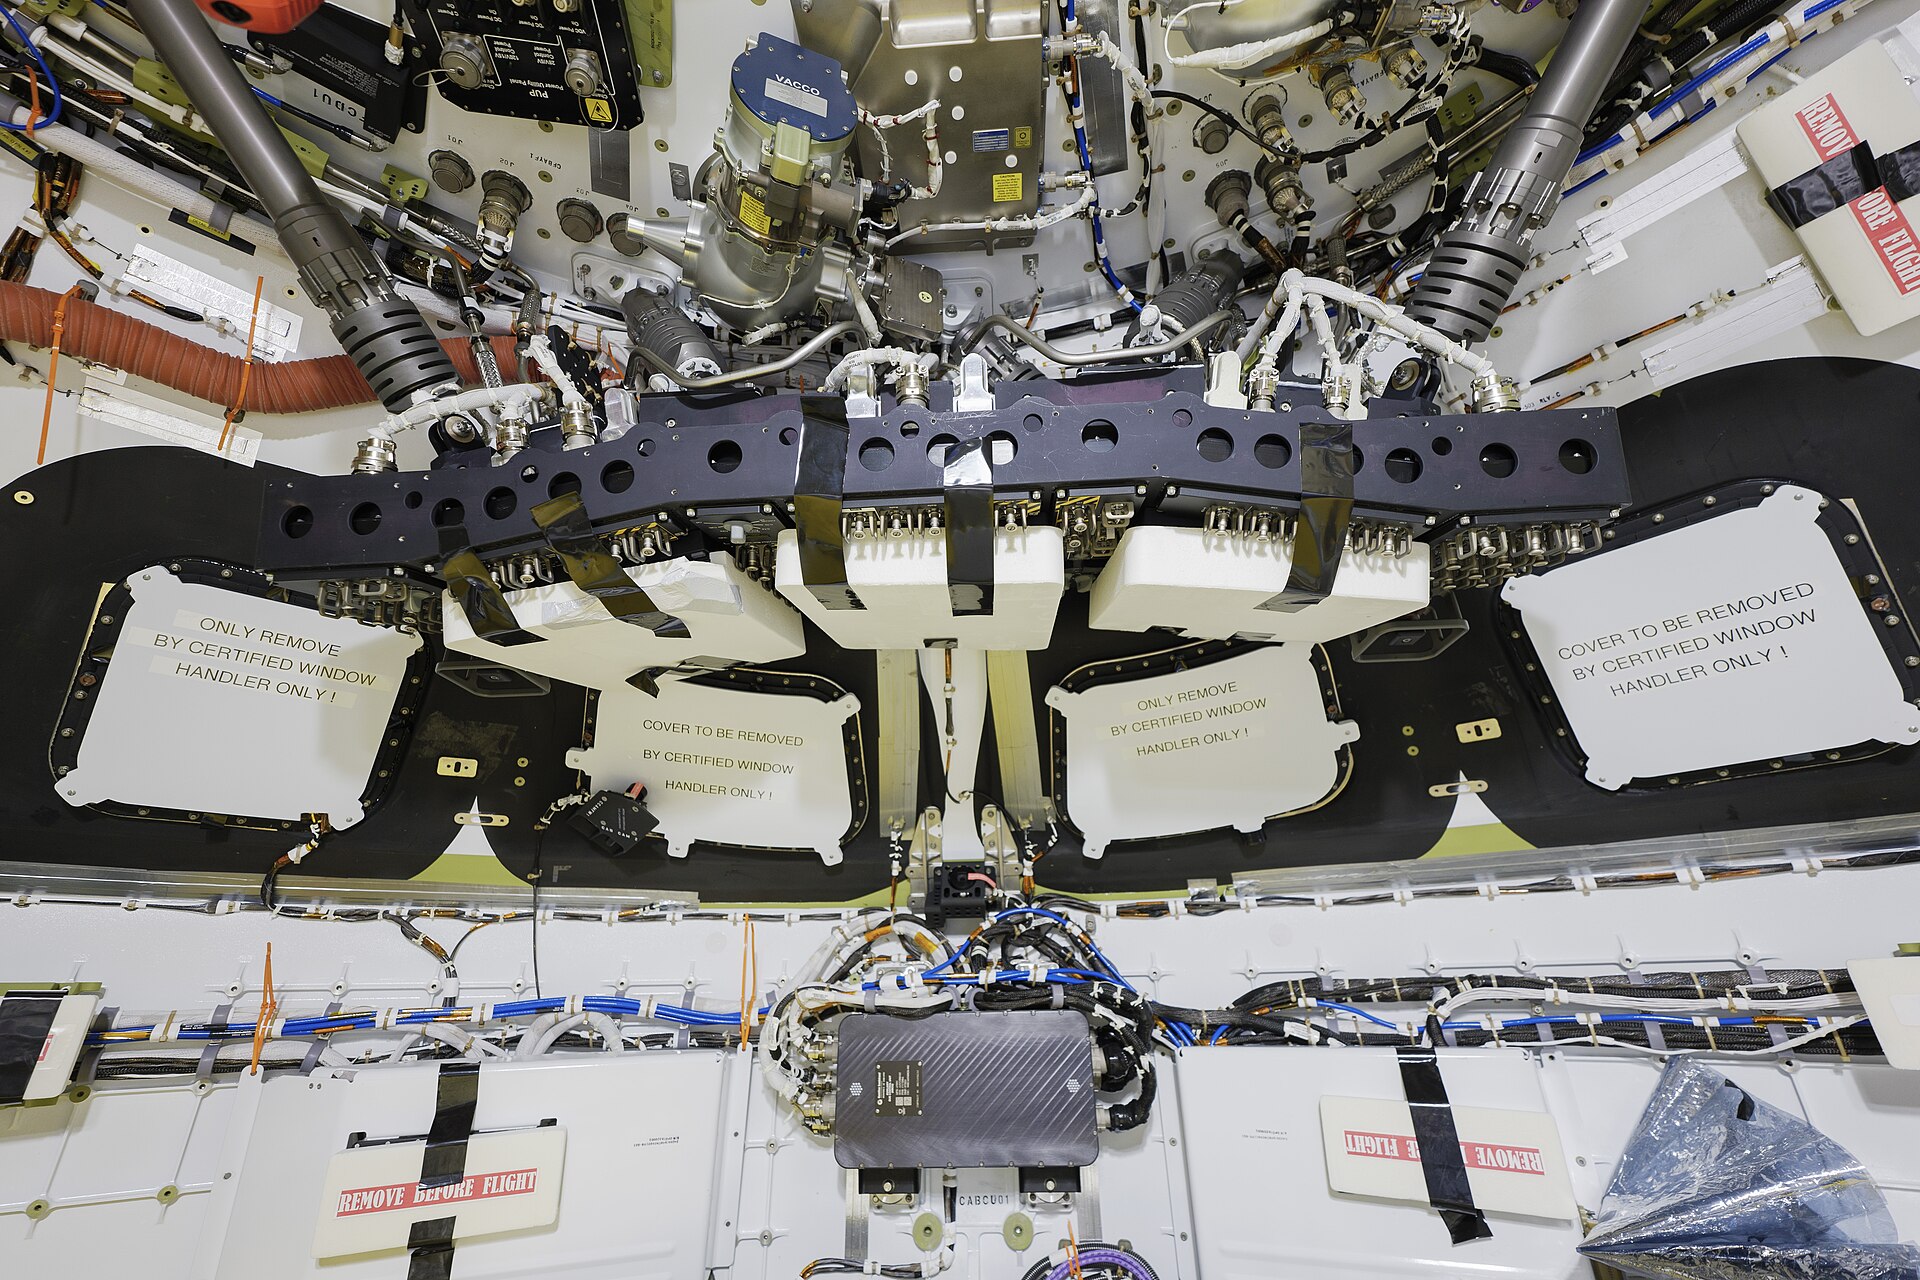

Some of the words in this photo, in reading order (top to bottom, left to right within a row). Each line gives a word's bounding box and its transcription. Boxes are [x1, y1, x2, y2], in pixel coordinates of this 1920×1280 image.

[509, 78, 527, 86] Panel
[526, 80, 545, 89] Utility
[529, 89, 549, 99] PUP
[544, 83, 564, 91] Power
[775, 73, 820, 96] VACCO
[448, 135, 463, 145] J01
[1802, 96, 1856, 157] REMOV
[1558, 632, 1626, 660] COVER
[1628, 624, 1658, 641] TO
[1662, 614, 1693, 633] BE
[1696, 582, 1814, 624] REMOVED
[199, 617, 255, 639] ONLY
[259, 629, 341, 657] REMOVE
[1572, 664, 1596, 681] BY
[1602, 636, 1710, 674] CERTIFIED
[1713, 608, 1816, 645] WINDOW
[153, 633, 184, 650] BY
[188, 641, 294, 671] CERTIFIED
[299, 661, 377, 686] WINDOW
[1610, 664, 1708, 697] HANDLER
[1712, 648, 1771, 674] ONLY
[175, 662, 271, 692] HANDLER
[276, 681, 327, 701] ONLY
[1137, 694, 1174, 711] ONLY
[1177, 681, 1238, 703] REMOVE
[1110, 724, 1128, 737] BY
[1131, 710, 1203, 733] CERTIFIED
[1205, 697, 1267, 719] WINDOW
[643, 719, 691, 734] COVER
[694, 725, 713, 737] TO
[716, 728, 734, 739] BE
[737, 730, 804, 747] REMOVED
[1136, 736, 1200, 757] HANDLER
[1203, 728, 1240, 745] ONLY
[643, 749, 661, 760] BY
[664, 751, 734, 769] CERTIFIED
[737, 760, 794, 775] WINDOW
[665, 780, 727, 796] HANDLER
[730, 787, 766, 800] ONLY
[1346, 1133, 1399, 1157] FLIGHT
[1475, 1146, 1544, 1171] REMOVE
[338, 1187, 404, 1213] REMOVE
[413, 1180, 475, 1204] BEFORE
[481, 1171, 537, 1196] FLIGHT
[959, 1194, 1009, 1206] CABCU01
